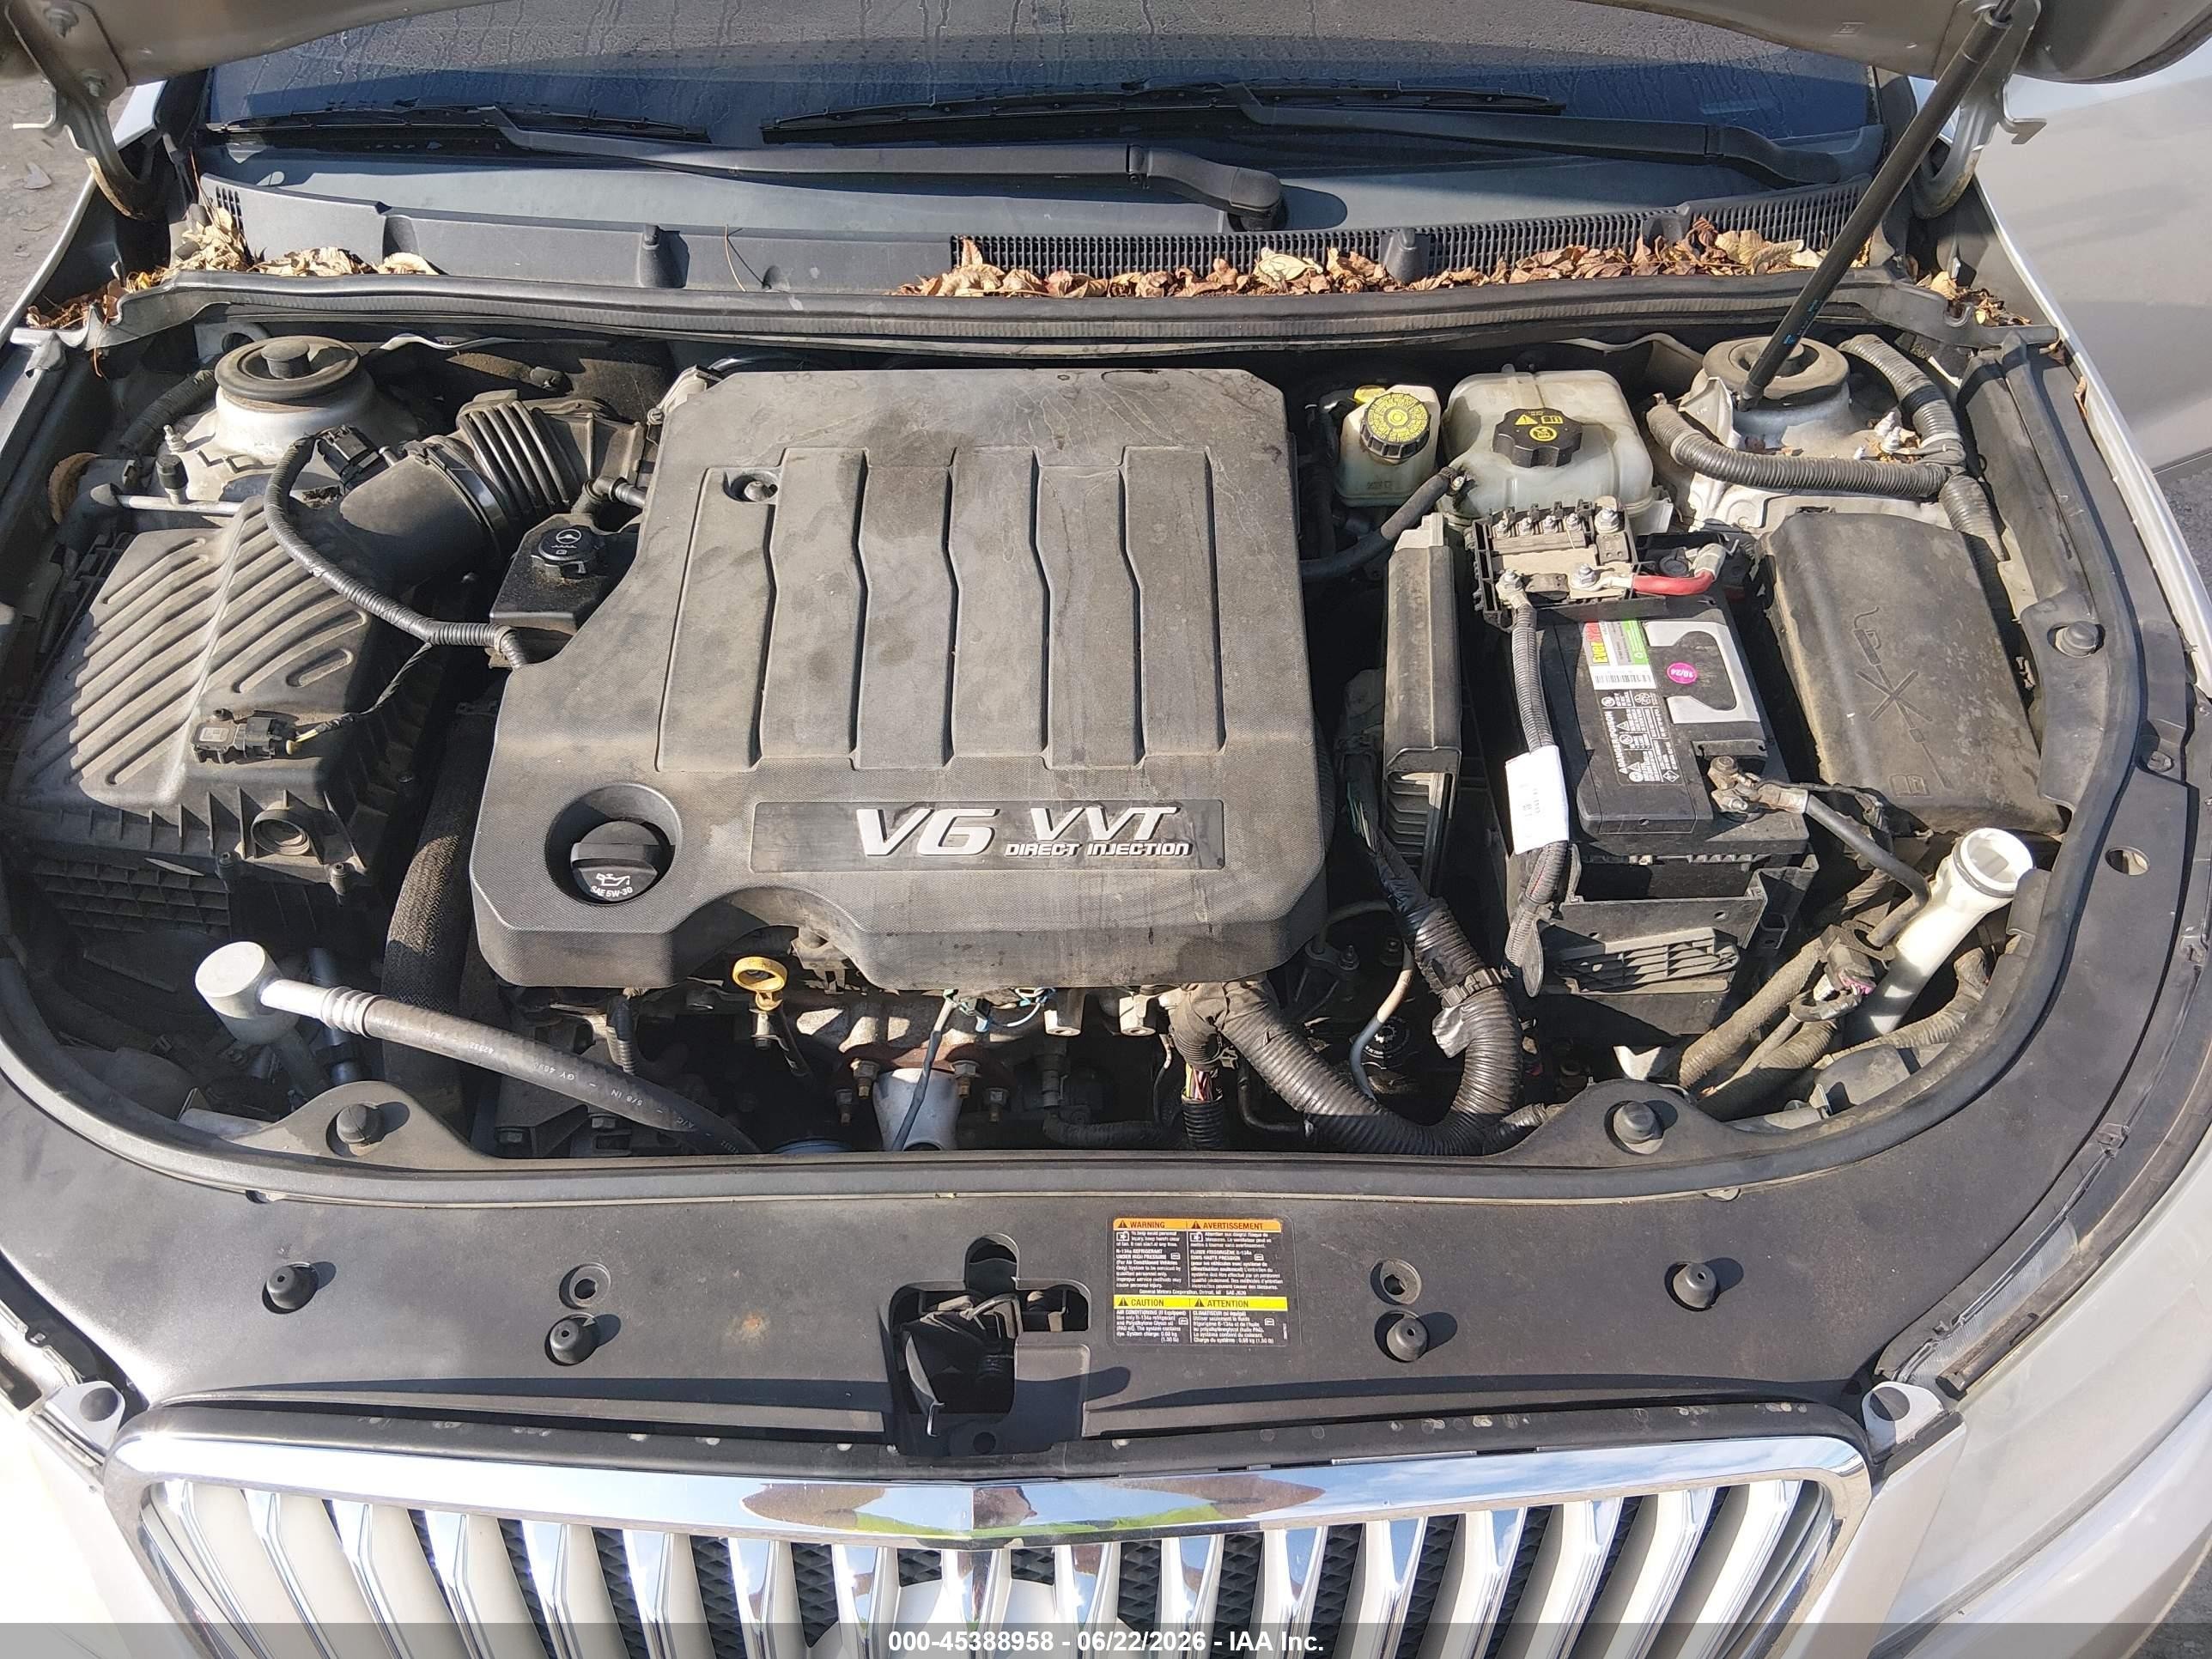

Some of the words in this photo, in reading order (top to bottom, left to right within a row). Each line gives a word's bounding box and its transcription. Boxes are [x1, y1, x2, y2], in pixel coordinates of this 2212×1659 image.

[856, 807, 1000, 856] V6
[1030, 806, 1180, 842] VVT
[1006, 843, 1080, 857] DIRECT
[1086, 842, 1193, 857] INJECTION
[590, 885, 605, 896] SAE
[606, 886, 633, 897] 5W-30
[611, 1088, 623, 1098] IN
[1131, 1298, 1164, 1307] CAUTION
